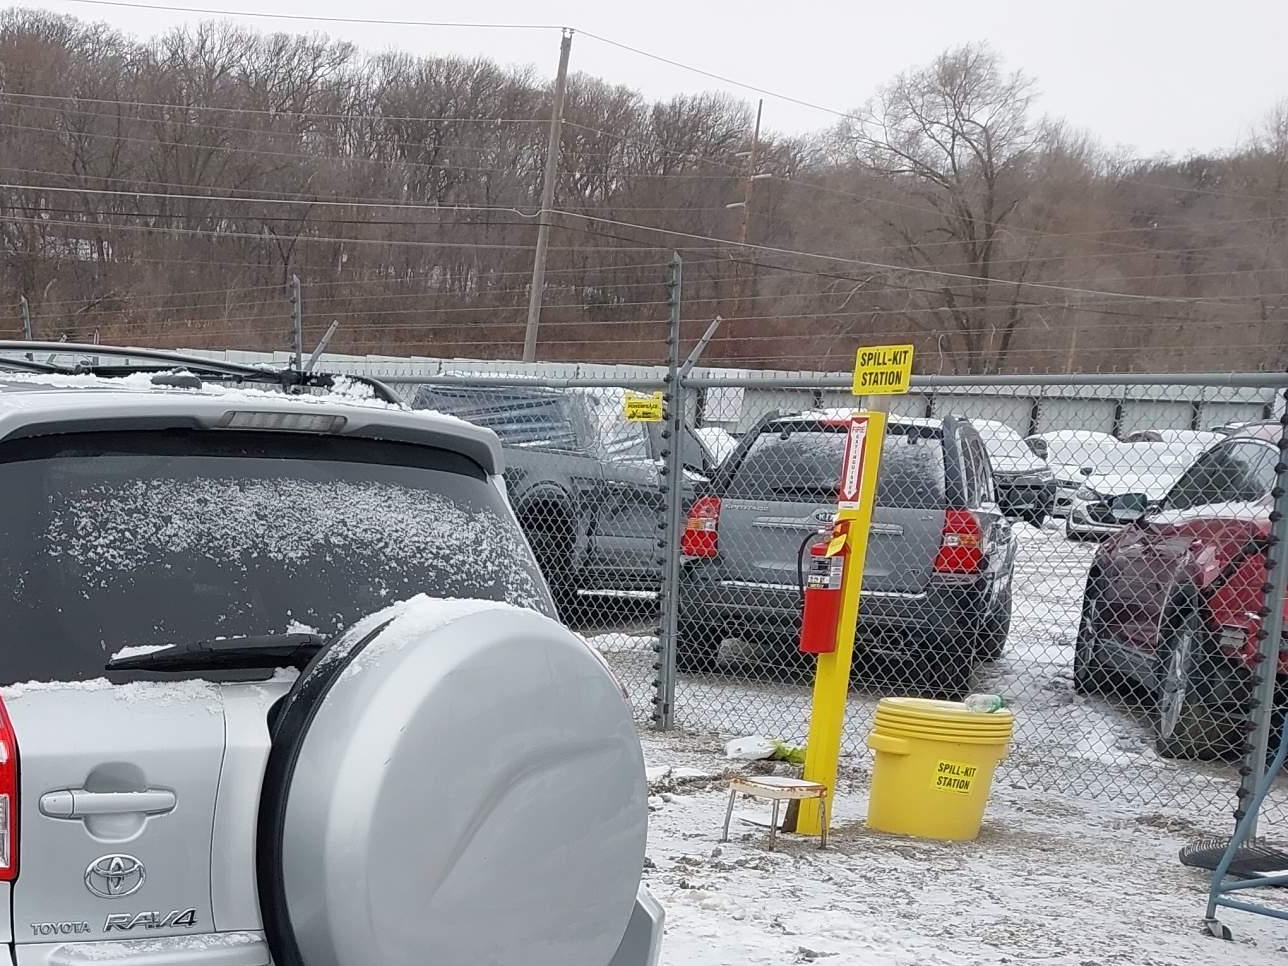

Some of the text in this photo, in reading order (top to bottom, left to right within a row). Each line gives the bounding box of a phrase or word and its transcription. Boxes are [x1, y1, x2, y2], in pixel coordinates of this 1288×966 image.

[860, 350, 909, 367] SPILL-KIT
[861, 371, 902, 386] STATION
[937, 762, 977, 777] SPILL-KIT
[937, 775, 971, 790] STATION
[31, 907, 199, 936] TOYOTA RAV4
